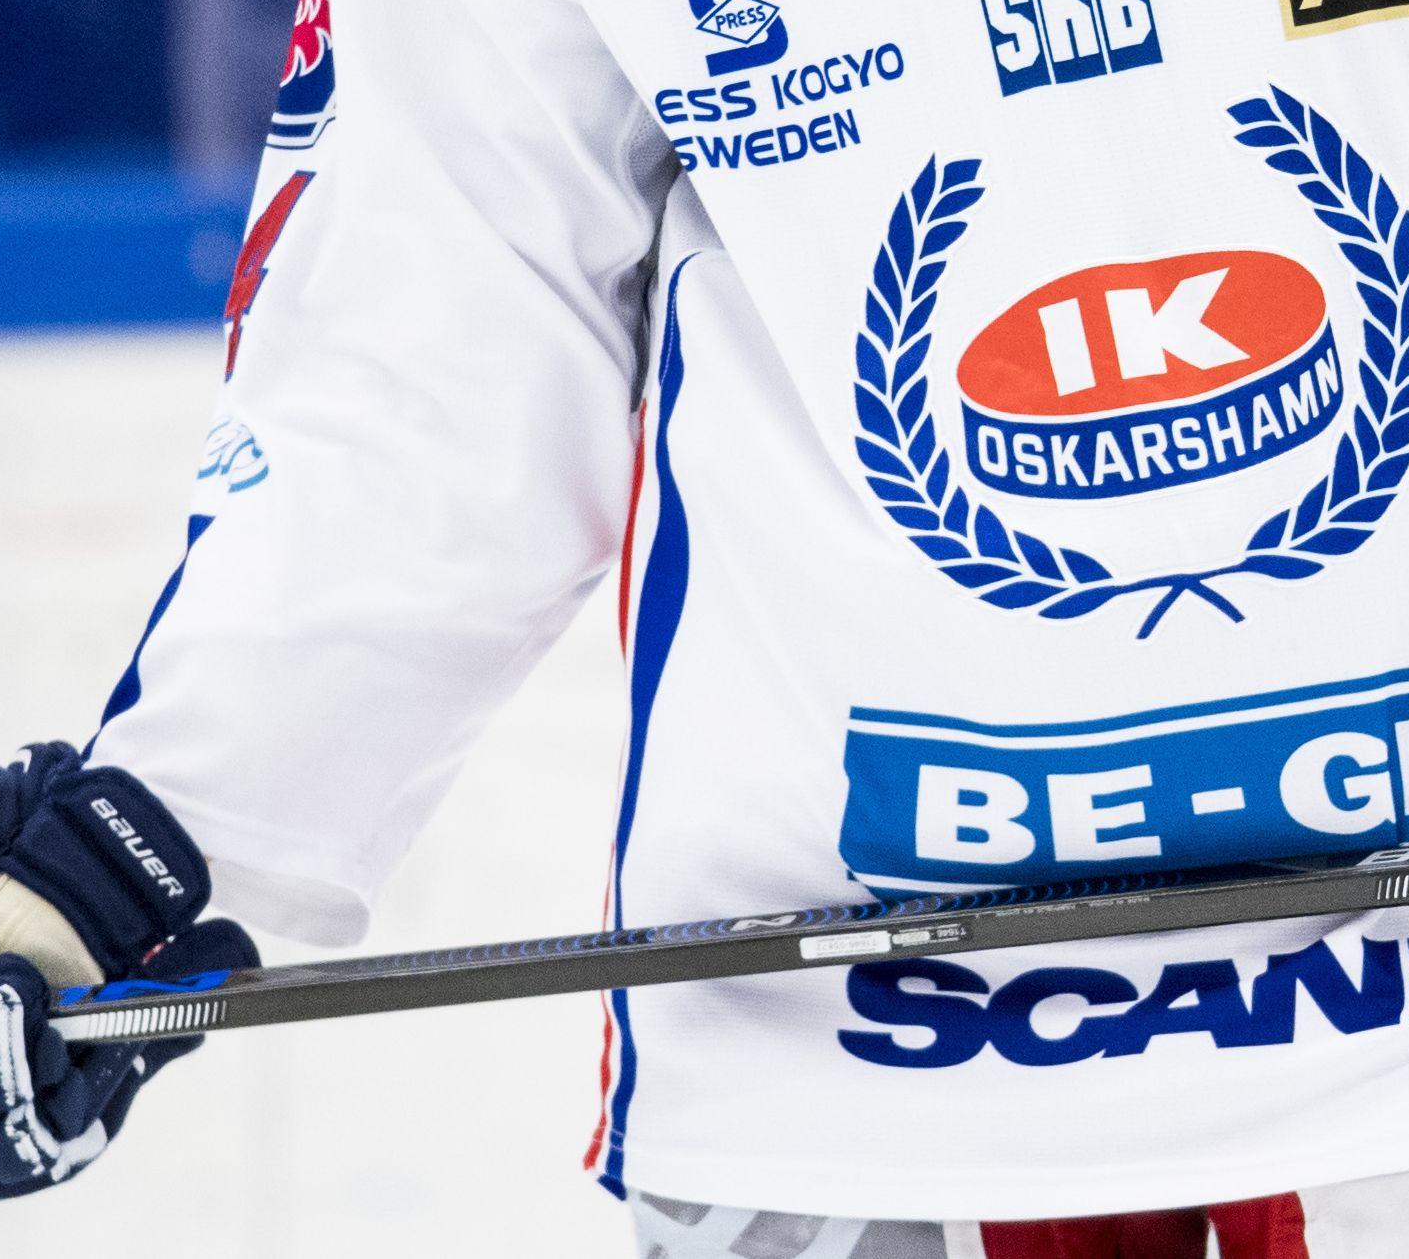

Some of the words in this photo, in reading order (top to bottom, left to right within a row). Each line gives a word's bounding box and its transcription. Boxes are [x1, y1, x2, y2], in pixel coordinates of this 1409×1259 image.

[715, 4, 767, 32] PRESS
[655, 80, 758, 125] ESS
[771, 42, 905, 111] KOGYO
[672, 108, 861, 173] SWEDEN
[1038, 266, 1252, 398] IK
[977, 346, 1342, 488] OSKARSHAMN
